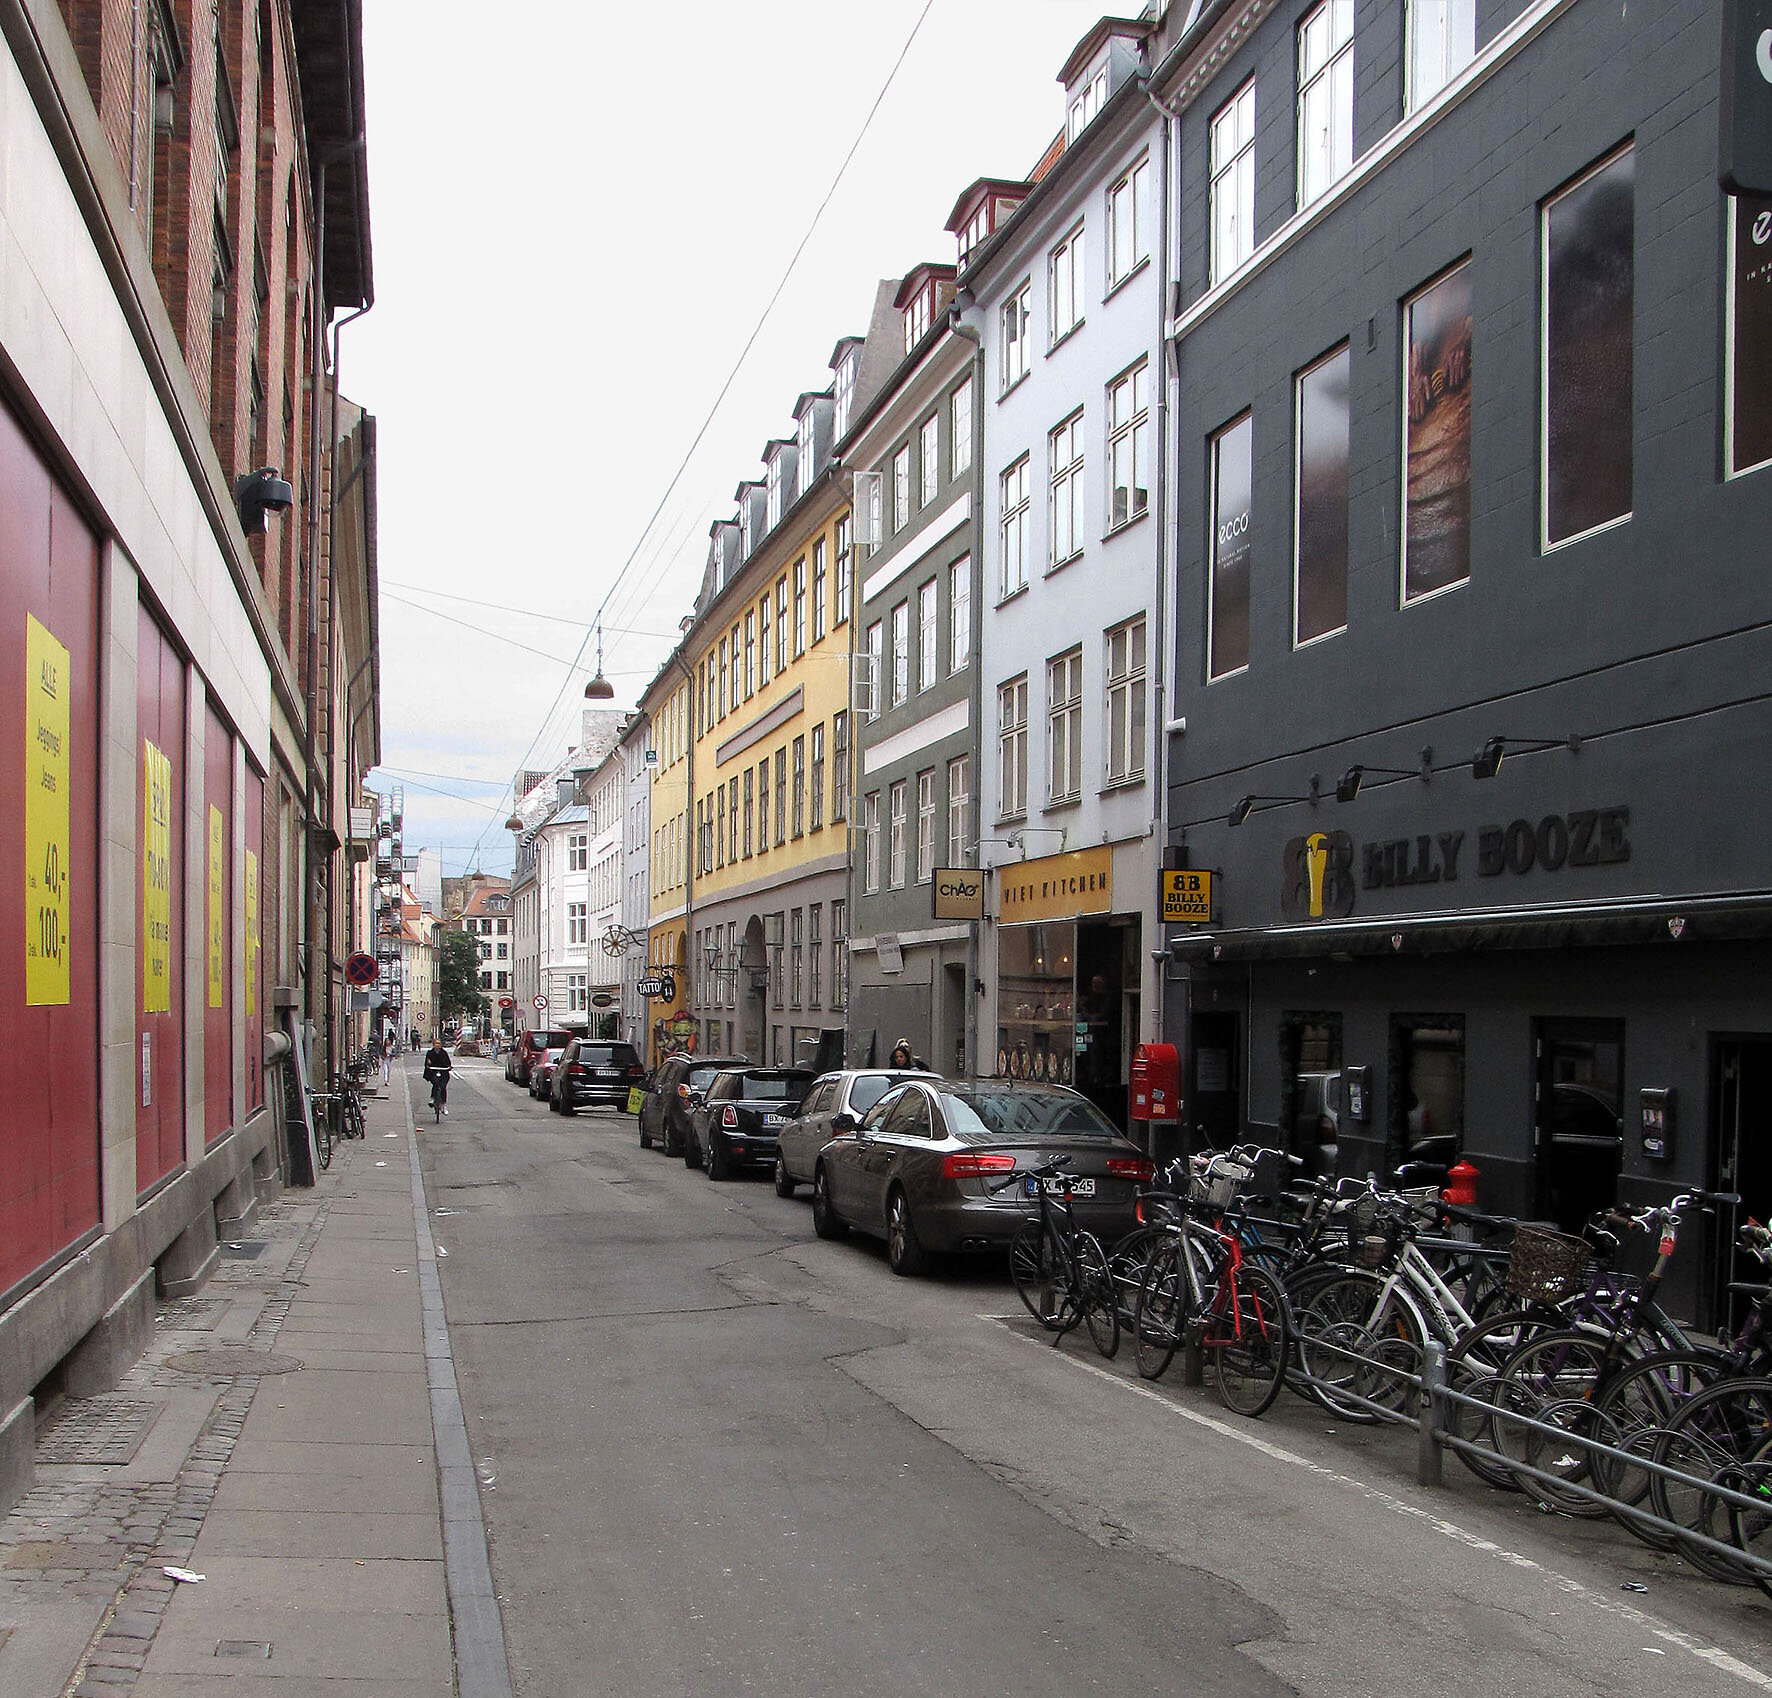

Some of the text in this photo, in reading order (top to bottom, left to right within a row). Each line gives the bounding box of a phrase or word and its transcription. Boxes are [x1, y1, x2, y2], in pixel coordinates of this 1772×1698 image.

[1219, 513, 1249, 545] ecco
[42, 659, 56, 695] ALLE
[41, 765, 56, 793] Jeans
[1361, 830, 1466, 891] BILLY
[1477, 804, 1632, 877] BOOZE
[1004, 872, 1106, 904] VIET KITCHEN
[1167, 892, 1206, 903] BILLY
[1164, 903, 1209, 913] BOOZE
[638, 982, 662, 995] TATTO
